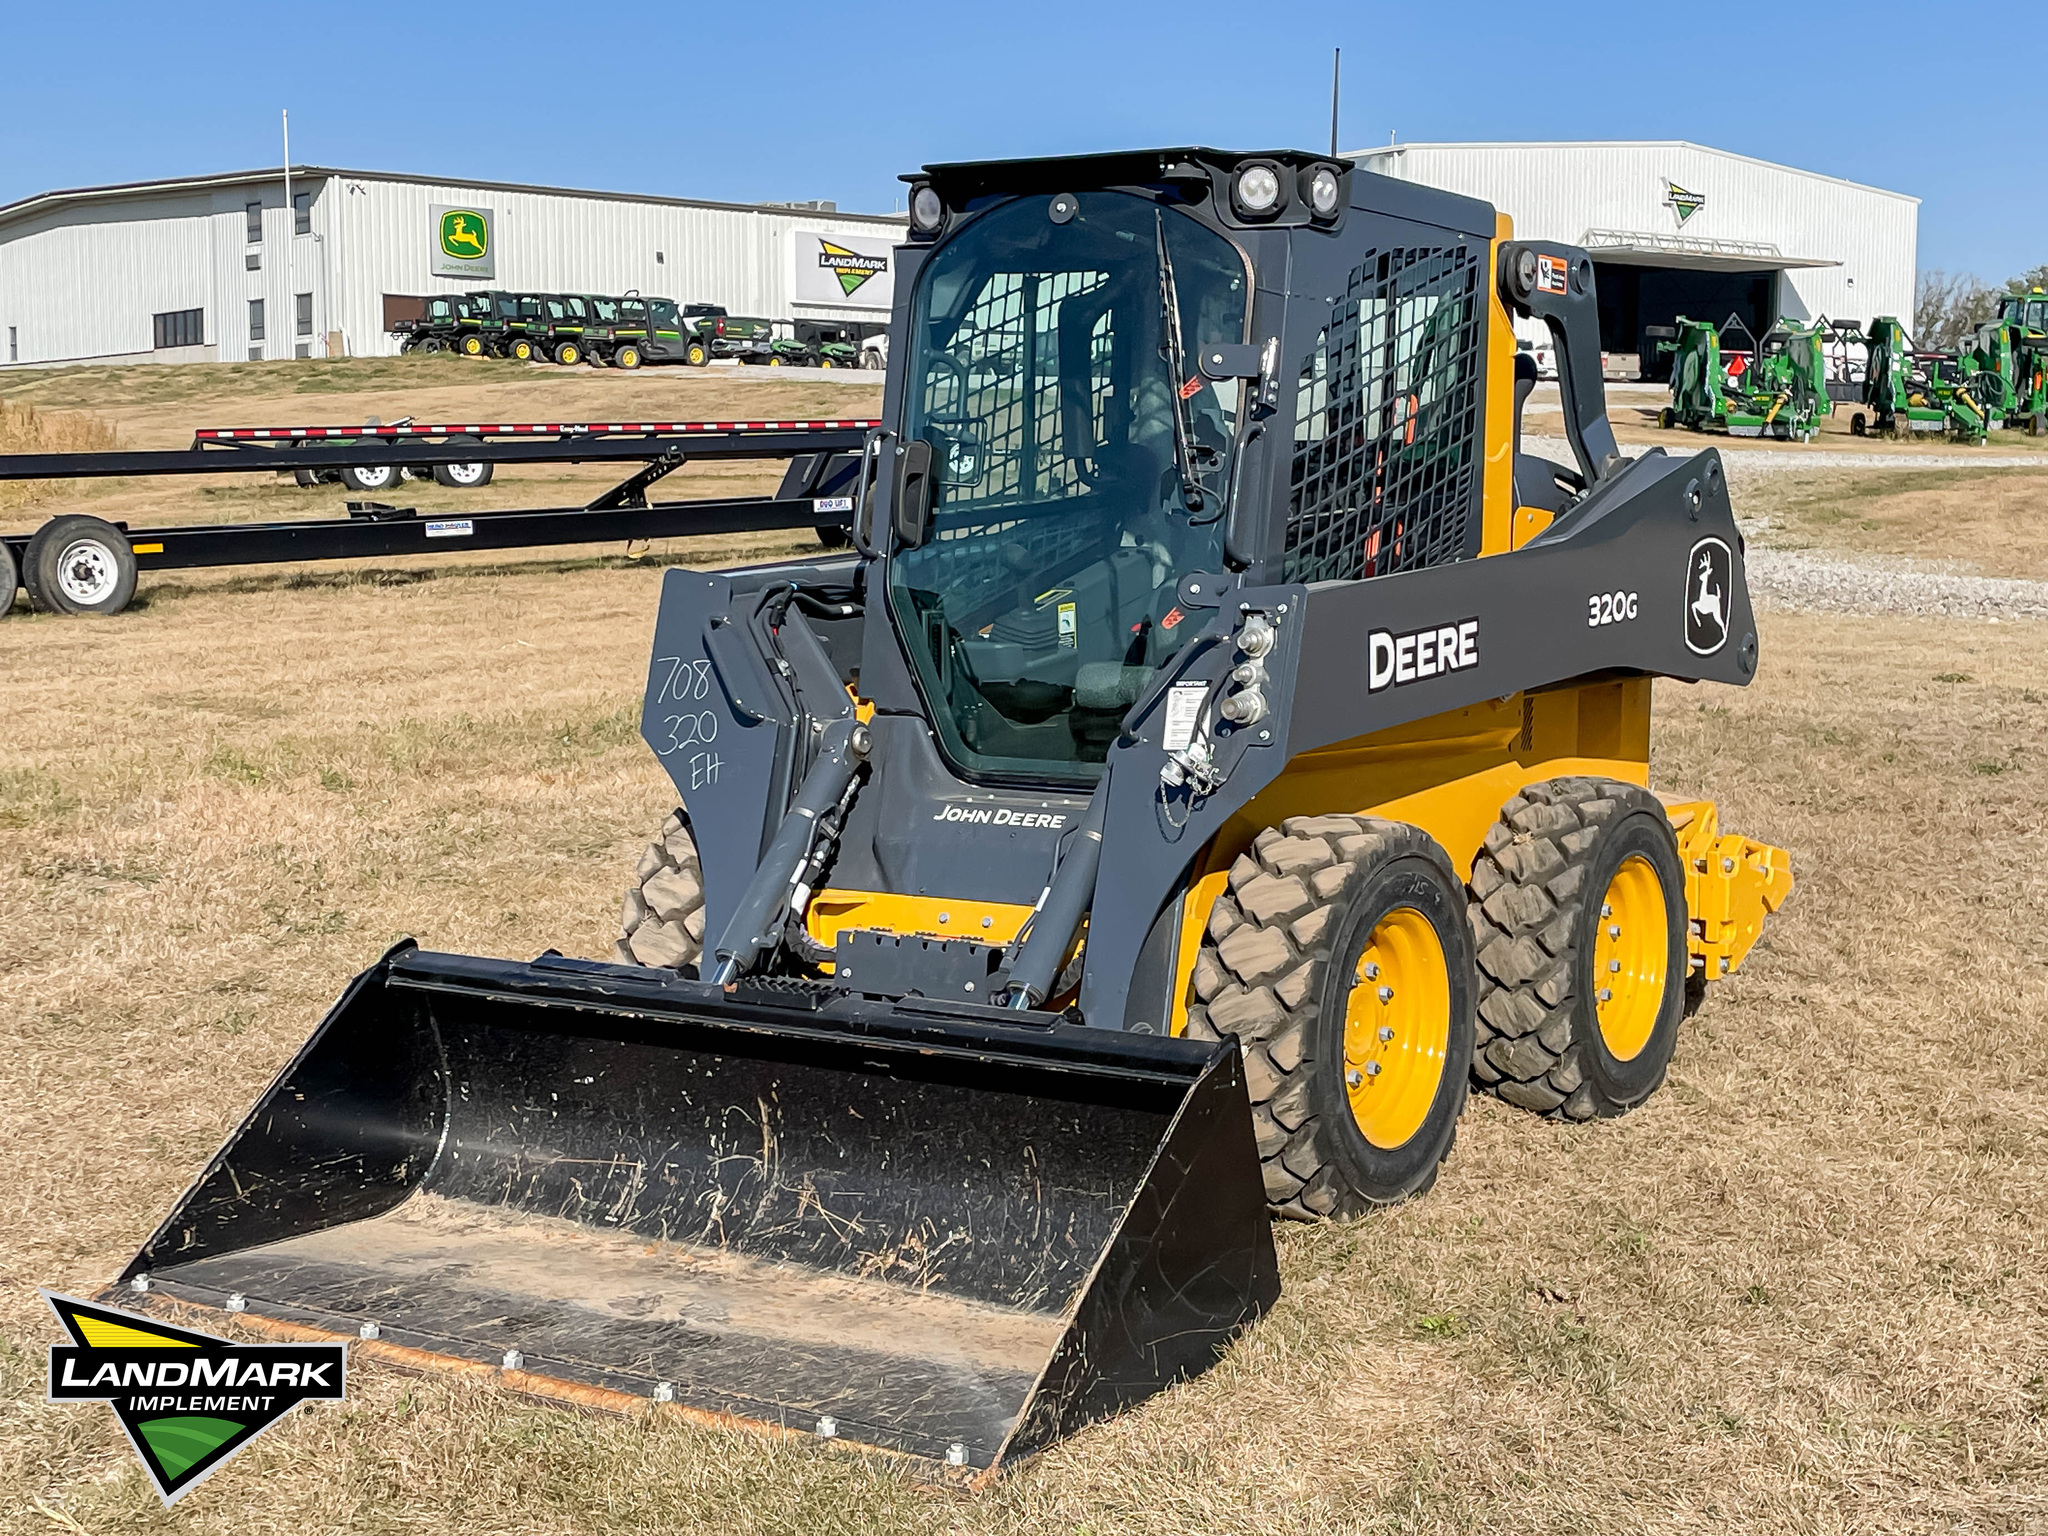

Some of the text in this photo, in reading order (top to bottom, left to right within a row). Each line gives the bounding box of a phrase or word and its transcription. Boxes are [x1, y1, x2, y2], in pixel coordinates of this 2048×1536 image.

[440, 263, 463, 271] JOHN
[820, 255, 886, 270] LANDMARK
[1588, 591, 1638, 627] 320G
[1369, 620, 1478, 690] DEERE
[656, 656, 711, 704] 708
[657, 710, 718, 755] 320
[689, 752, 726, 790] EH
[933, 804, 1067, 828] JOHN DEERE
